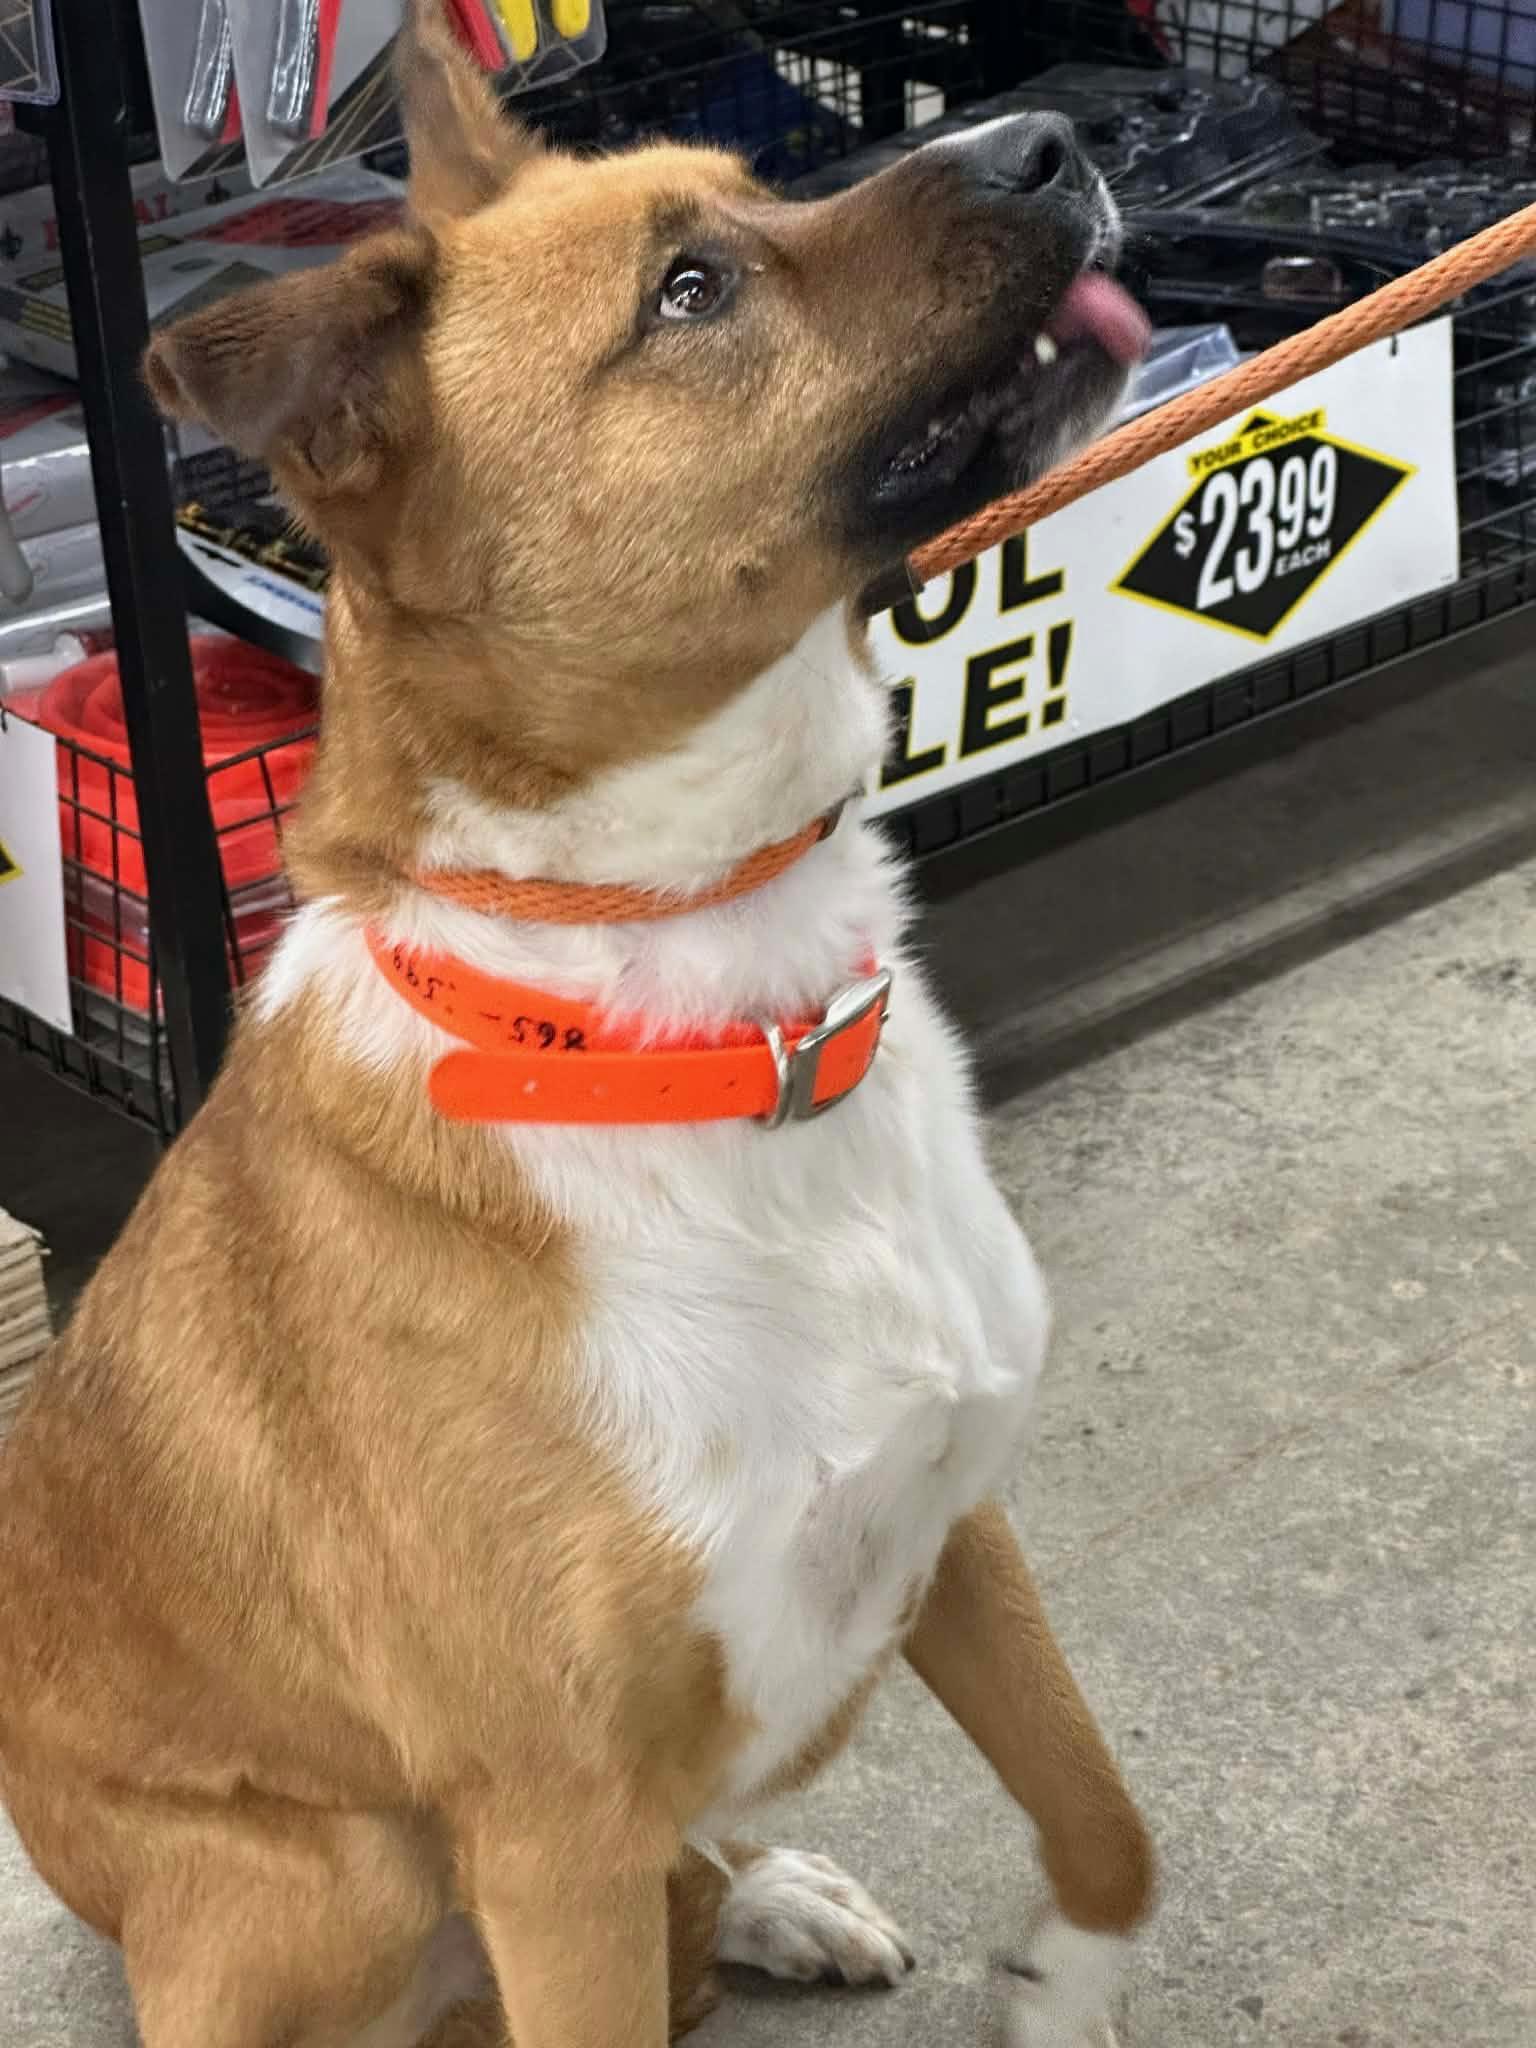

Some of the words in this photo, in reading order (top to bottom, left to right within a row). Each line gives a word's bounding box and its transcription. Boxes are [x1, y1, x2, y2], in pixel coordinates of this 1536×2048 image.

[1191, 441, 1243, 470] YOUR
[1252, 411, 1321, 450] CHOICE
[1274, 540, 1332, 577] EACH
